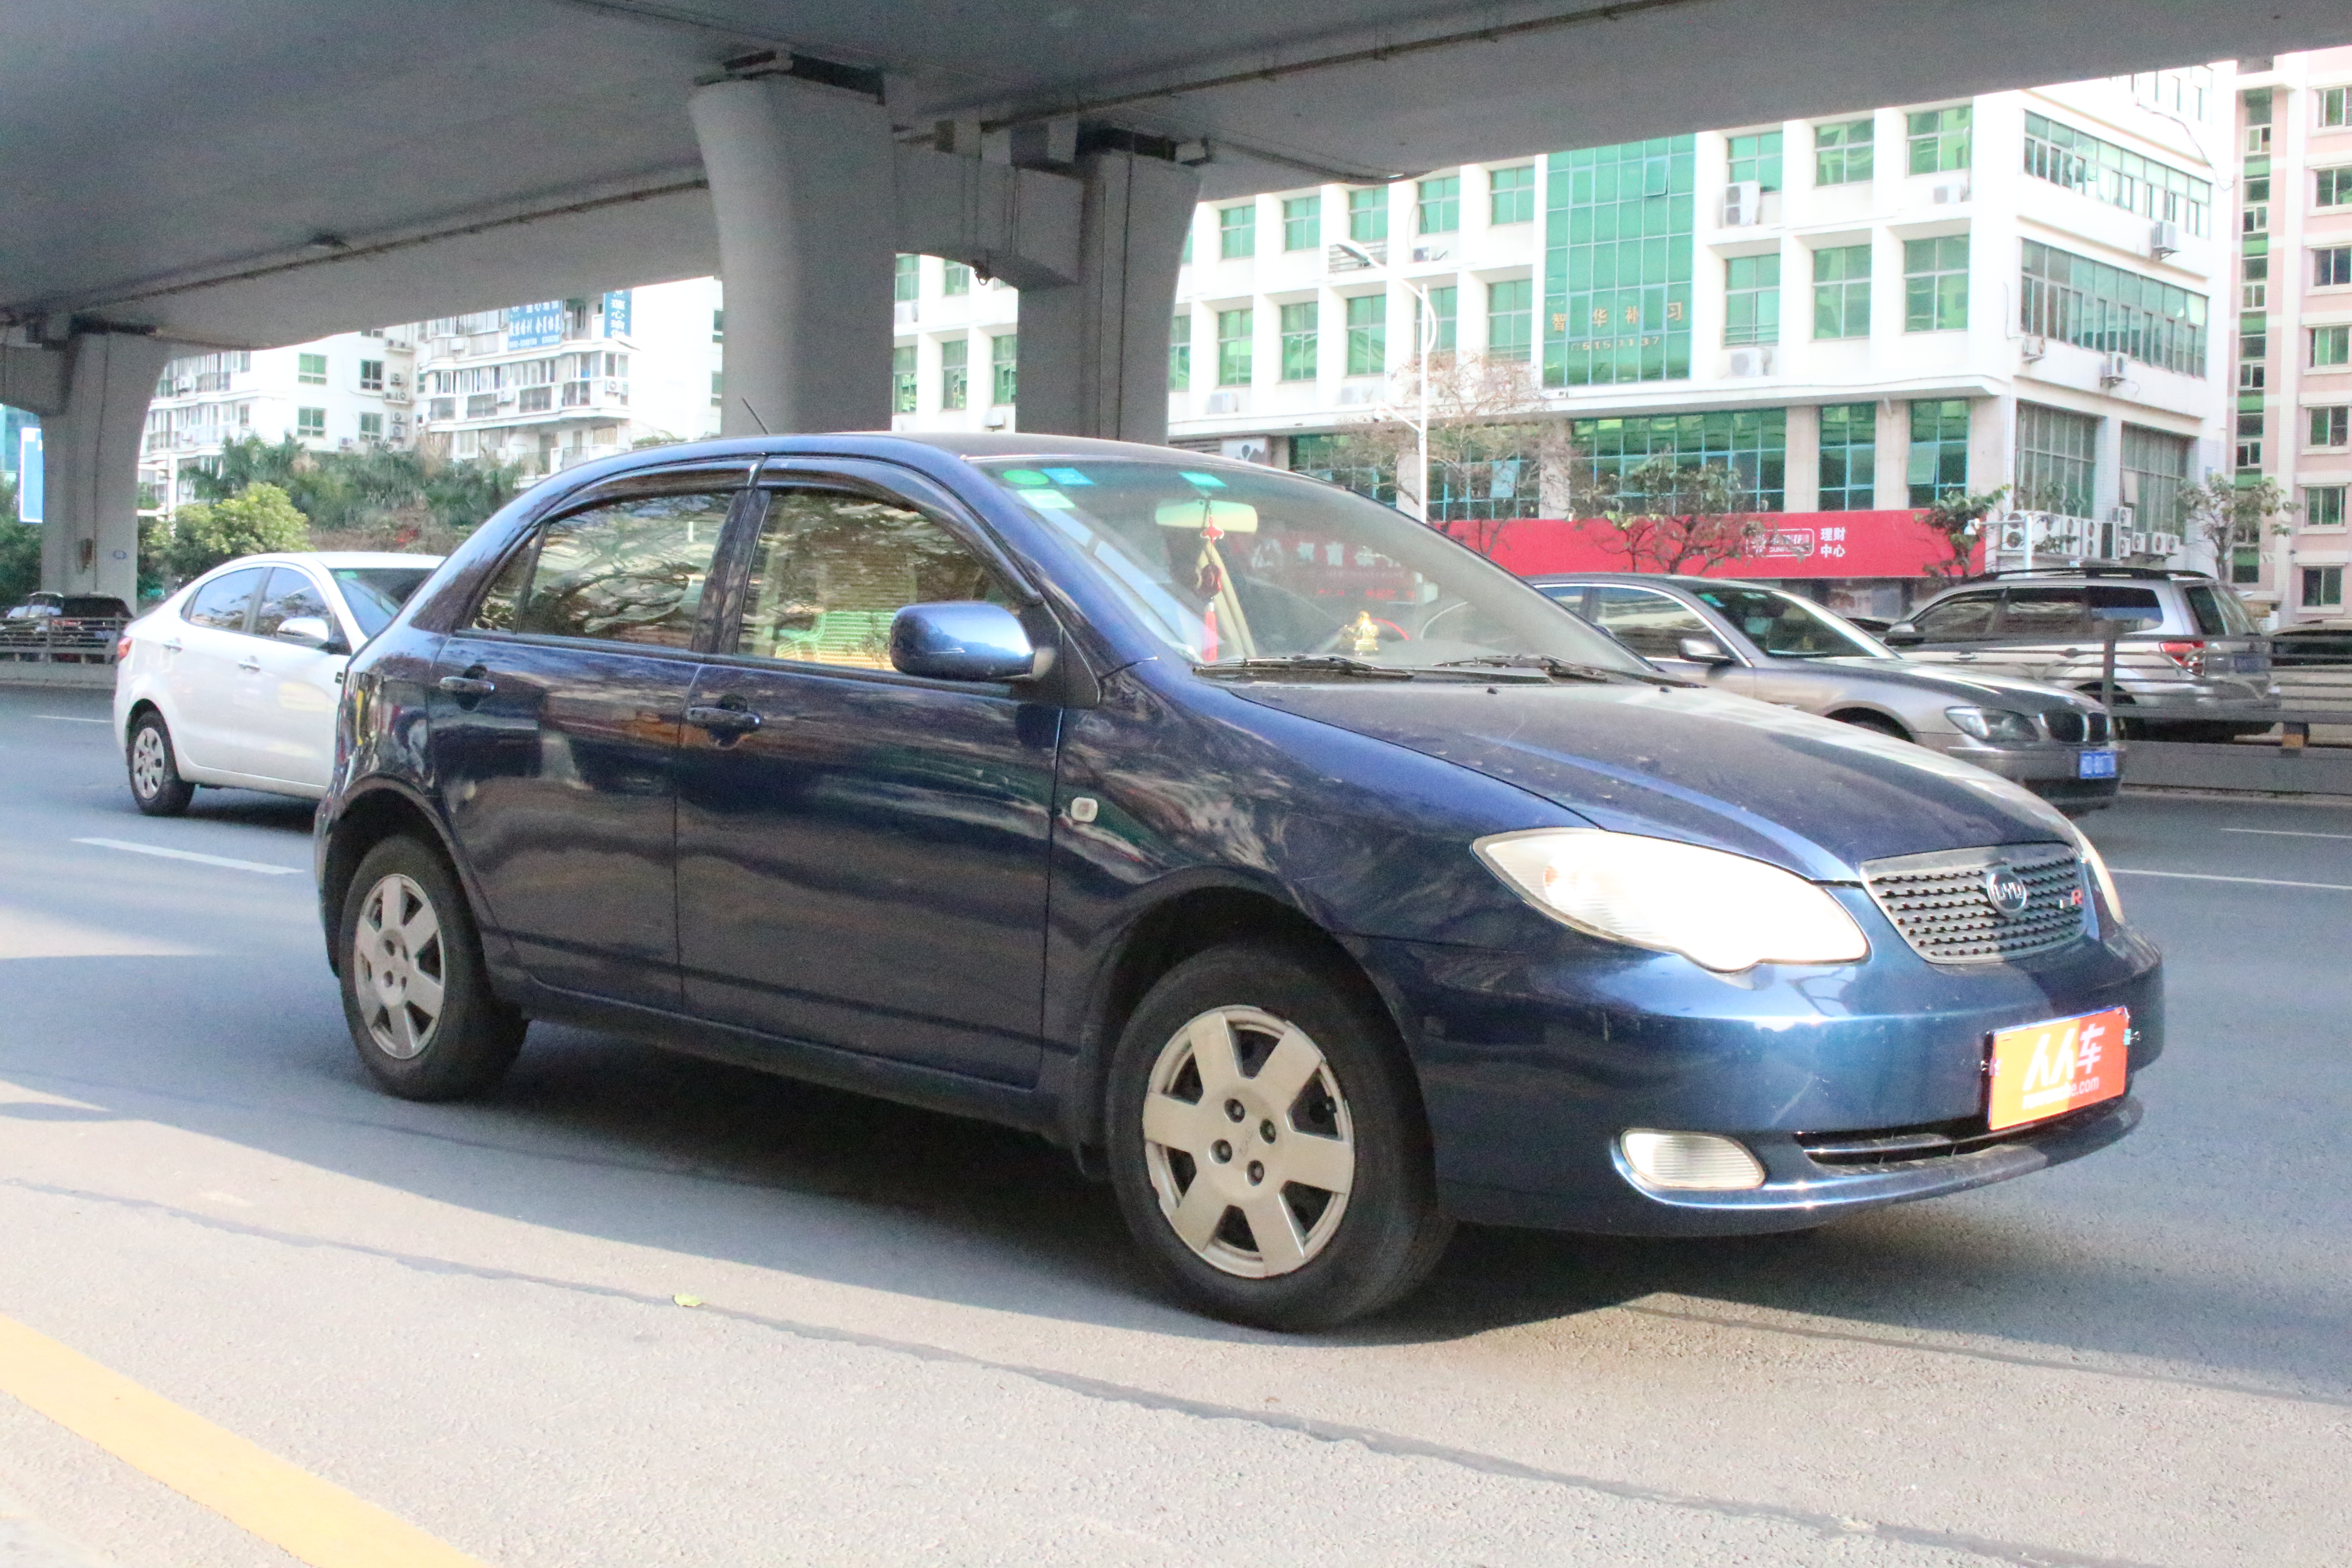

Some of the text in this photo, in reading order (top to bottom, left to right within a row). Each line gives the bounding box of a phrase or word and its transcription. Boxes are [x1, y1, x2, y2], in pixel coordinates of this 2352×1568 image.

[1552, 302, 1683, 331] 智华补习
[1820, 527, 1846, 541] 理财
[1820, 544, 1846, 558] 中心
